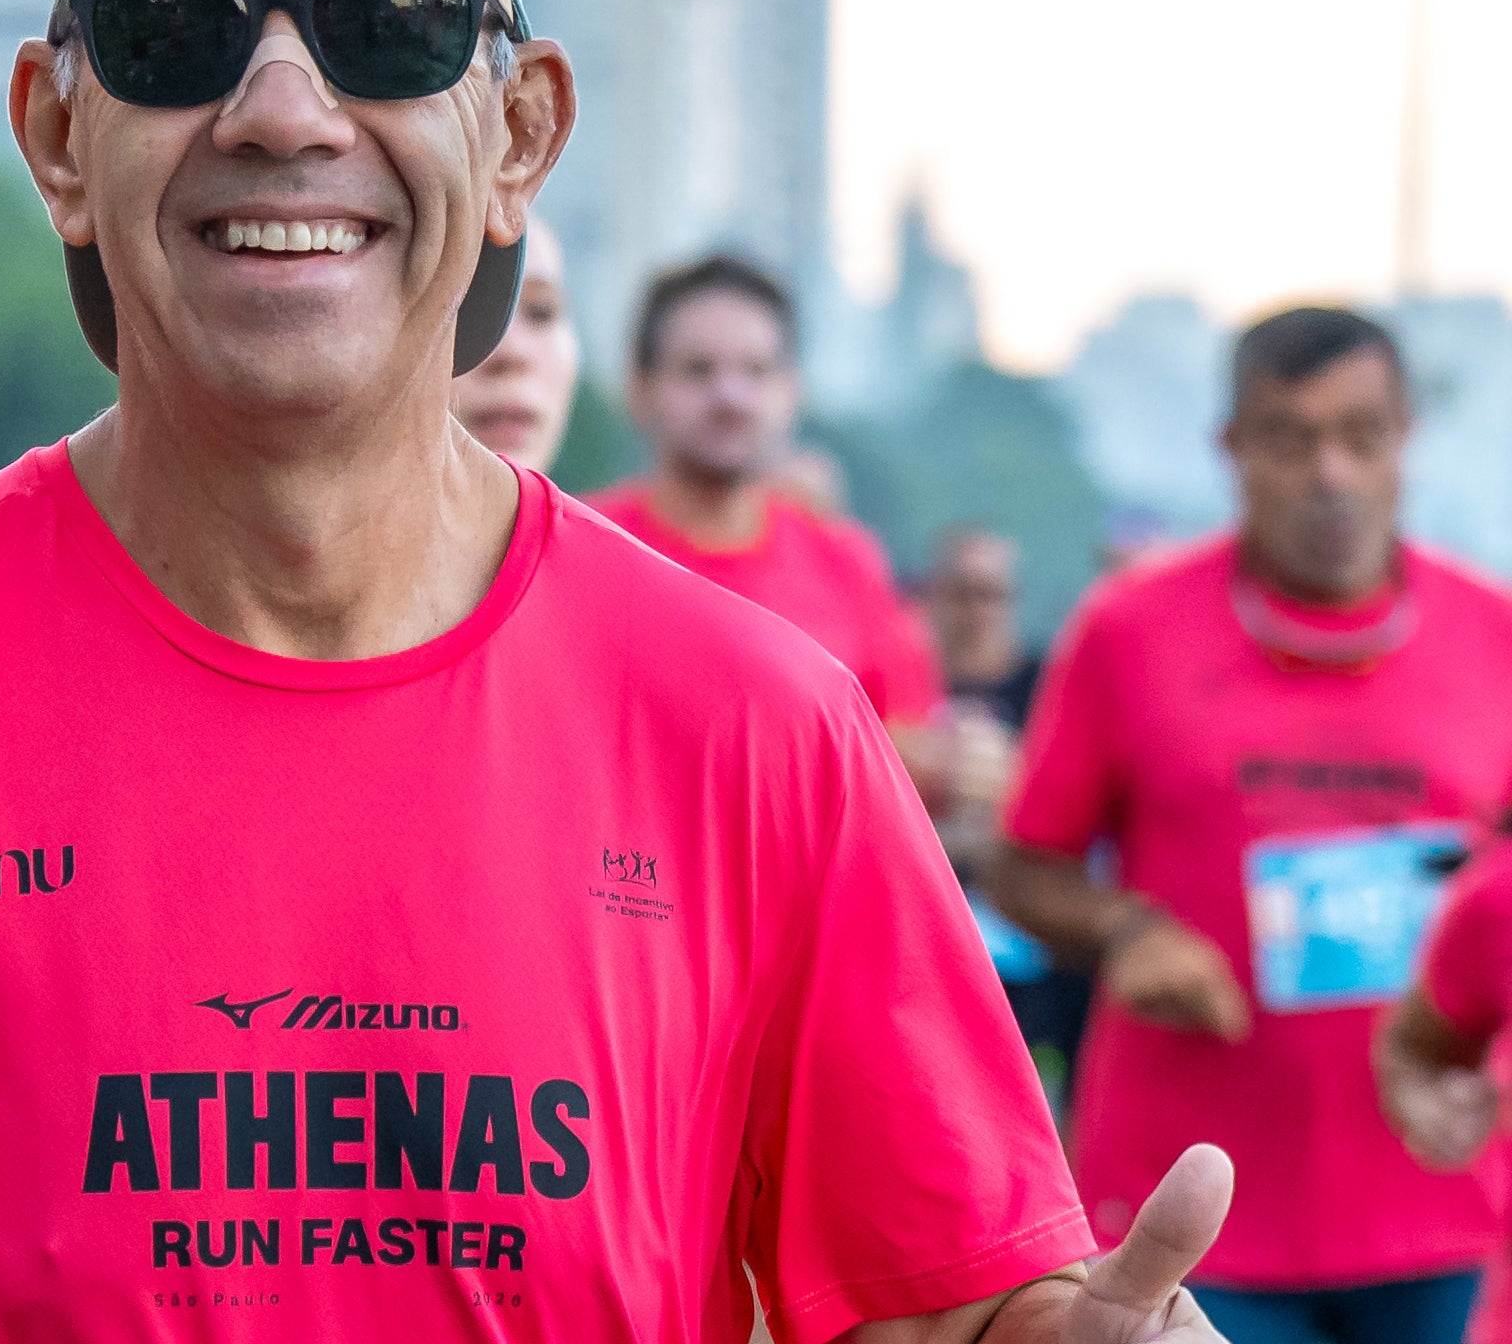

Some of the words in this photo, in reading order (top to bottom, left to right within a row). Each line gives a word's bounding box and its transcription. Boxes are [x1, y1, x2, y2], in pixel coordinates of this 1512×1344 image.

[82, 1071, 591, 1201] ATHENAS
[151, 1219, 281, 1269] RUN
[300, 1219, 527, 1271] FASTER
